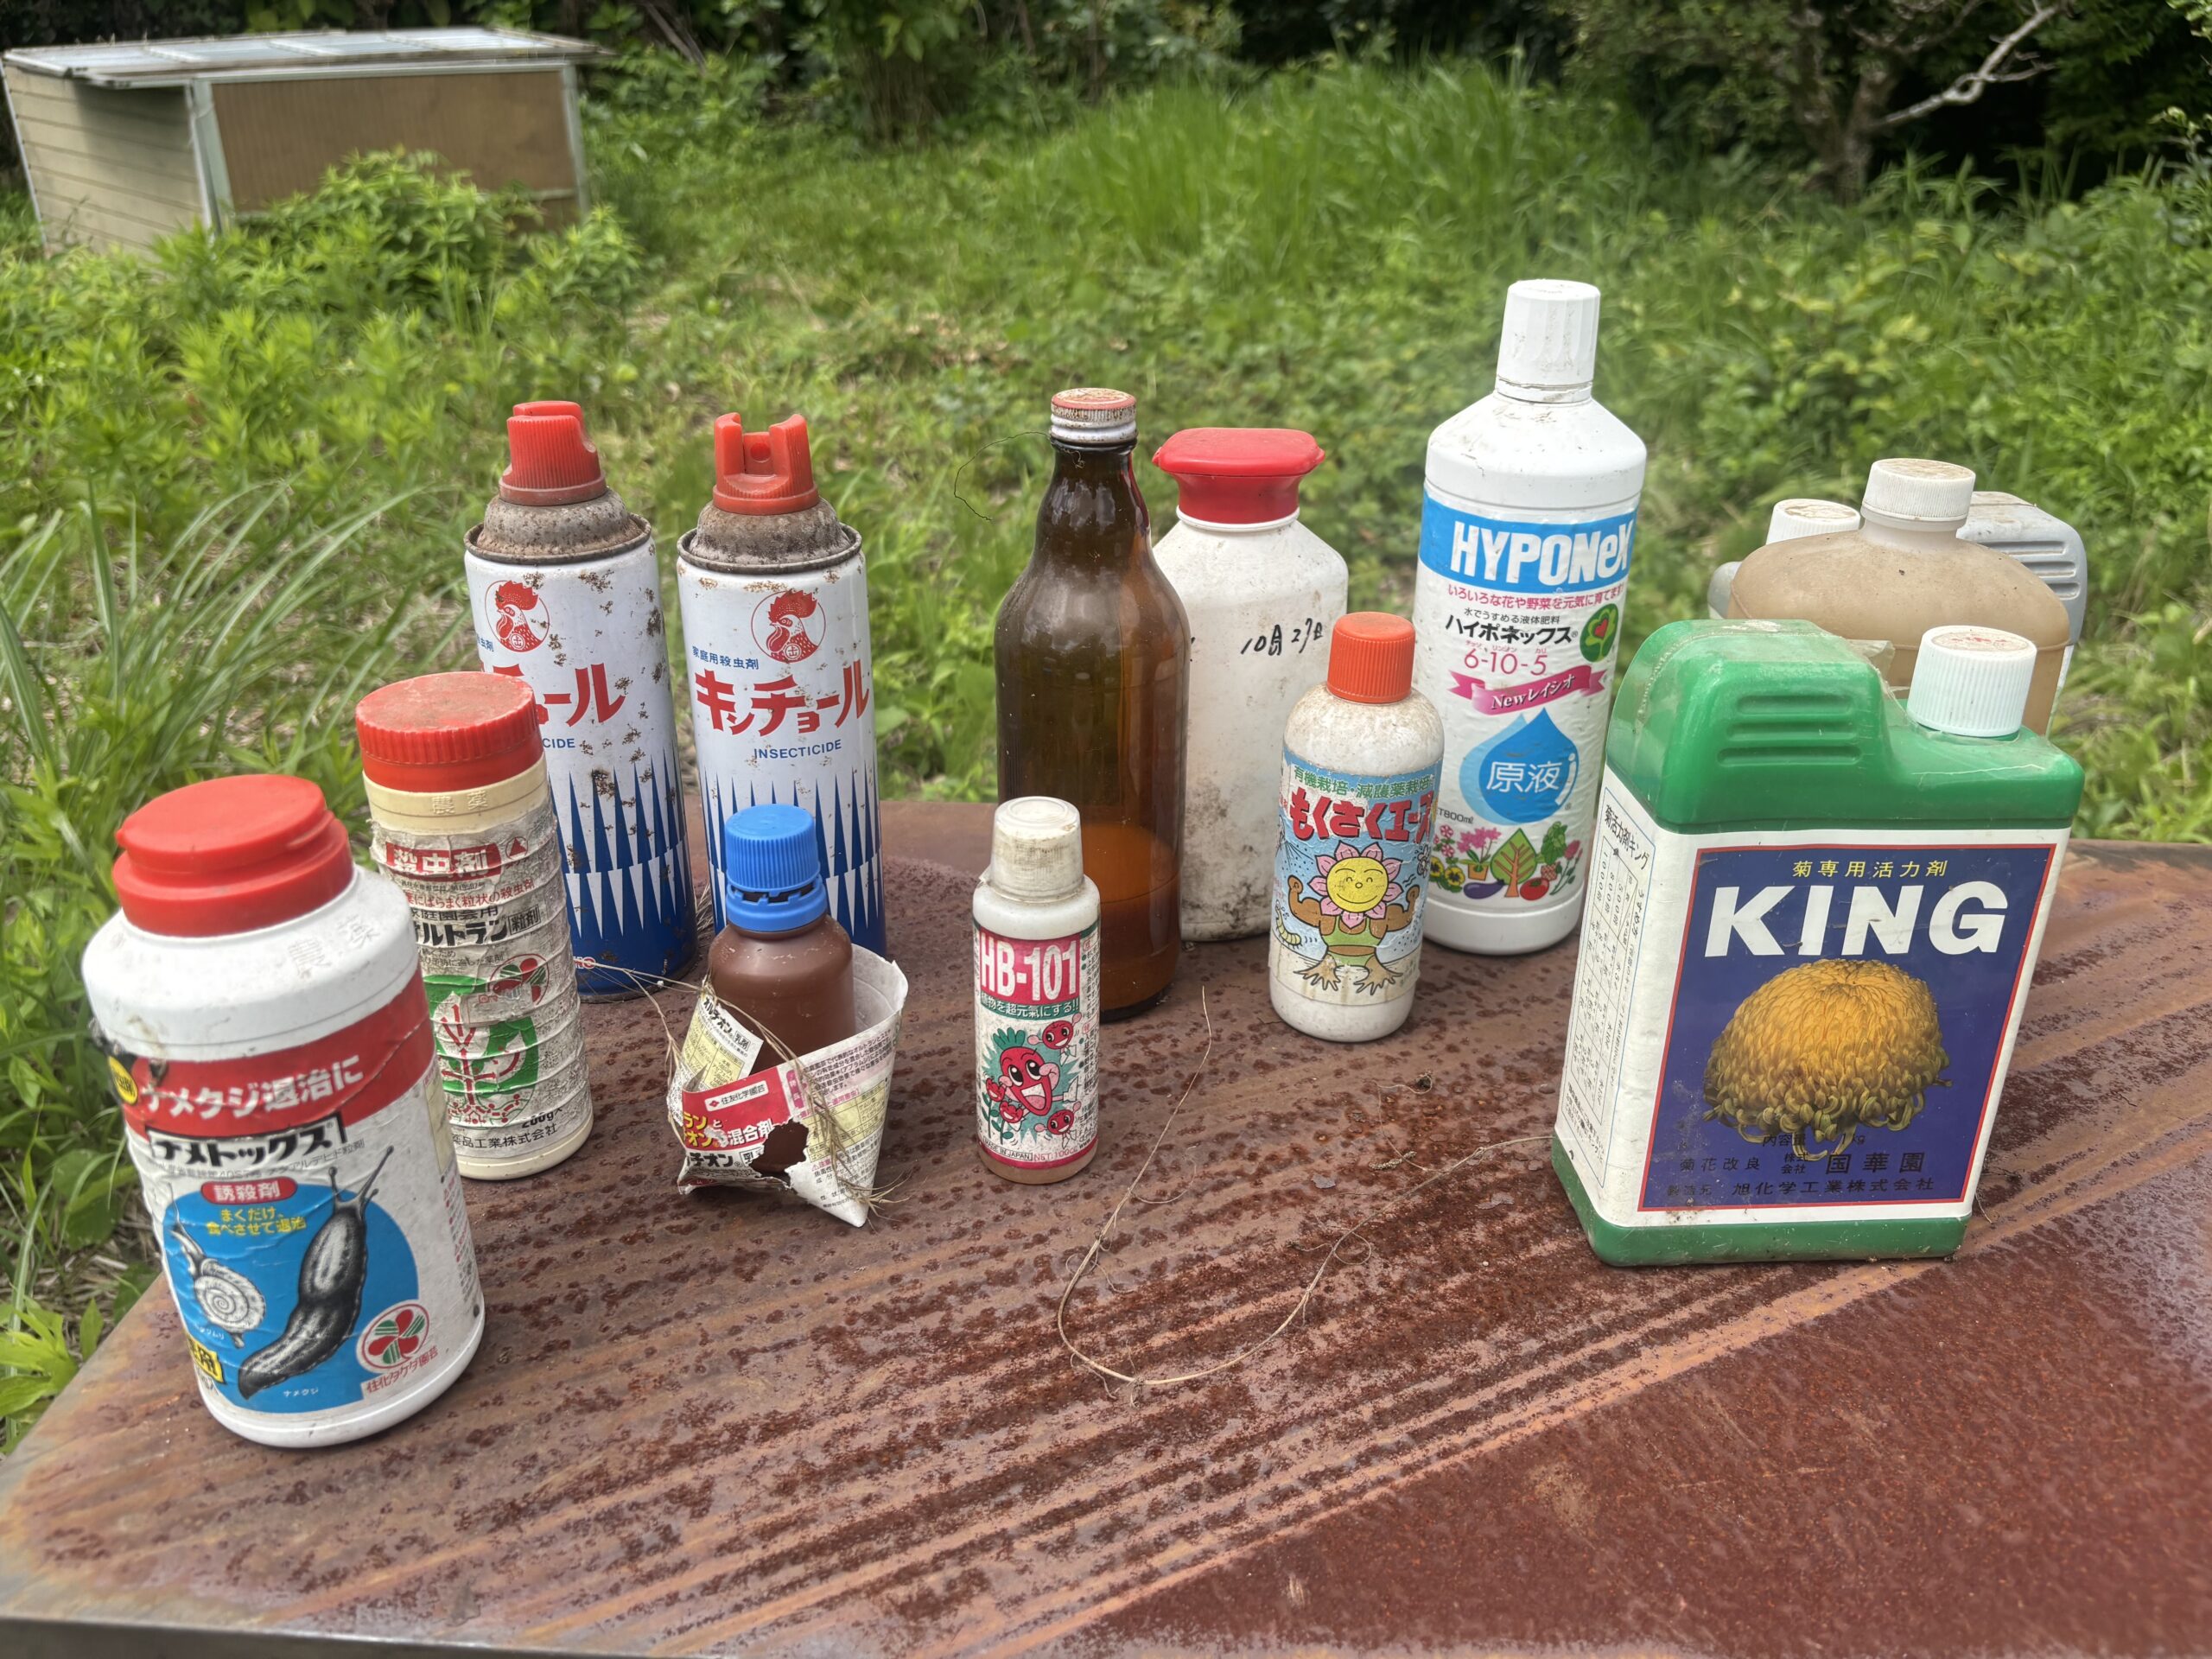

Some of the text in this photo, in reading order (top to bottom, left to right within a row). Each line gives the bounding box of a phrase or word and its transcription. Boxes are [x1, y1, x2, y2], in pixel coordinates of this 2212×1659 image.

[1463, 607, 1561, 626] 水でうすめる液体肥料
[1445, 614, 1573, 645] ハイポネックス
[691, 645, 760, 671] 家庭用殺虫剤
[1464, 648, 1549, 677] 6-10-5
[695, 658, 870, 737] キンチョール
[753, 739, 842, 760] INSECTICIDE
[1486, 760, 1563, 793] 原液
[1289, 786, 1435, 844] もくさくエース
[1792, 859, 1948, 878] 菊専用活力剤
[510, 906, 541, 934] 粒剤
[1704, 880, 2009, 958] KING
[981, 931, 1077, 1001] HB-101
[721, 1084, 766, 1106] 住友化学園芸
[713, 1119, 722, 1128] と
[727, 1118, 775, 1146] 混合剤
[155, 1125, 334, 1166] ナメトックス
[1762, 1133, 1807, 1147] 内容量
[1007, 1149, 1030, 1160] JAPAN
[1825, 1152, 1926, 1175] 国華園
[1781, 1163, 1807, 1175] 会社
[213, 1179, 282, 1203] 誘殺剤
[1731, 1177, 1935, 1197] 旭化学工業株式会社
[207, 1216, 308, 1236] 食べさせて退治
[366, 1344, 439, 1394] 住化タケダ園芸
[283, 1386, 319, 1398] ナメクジ
